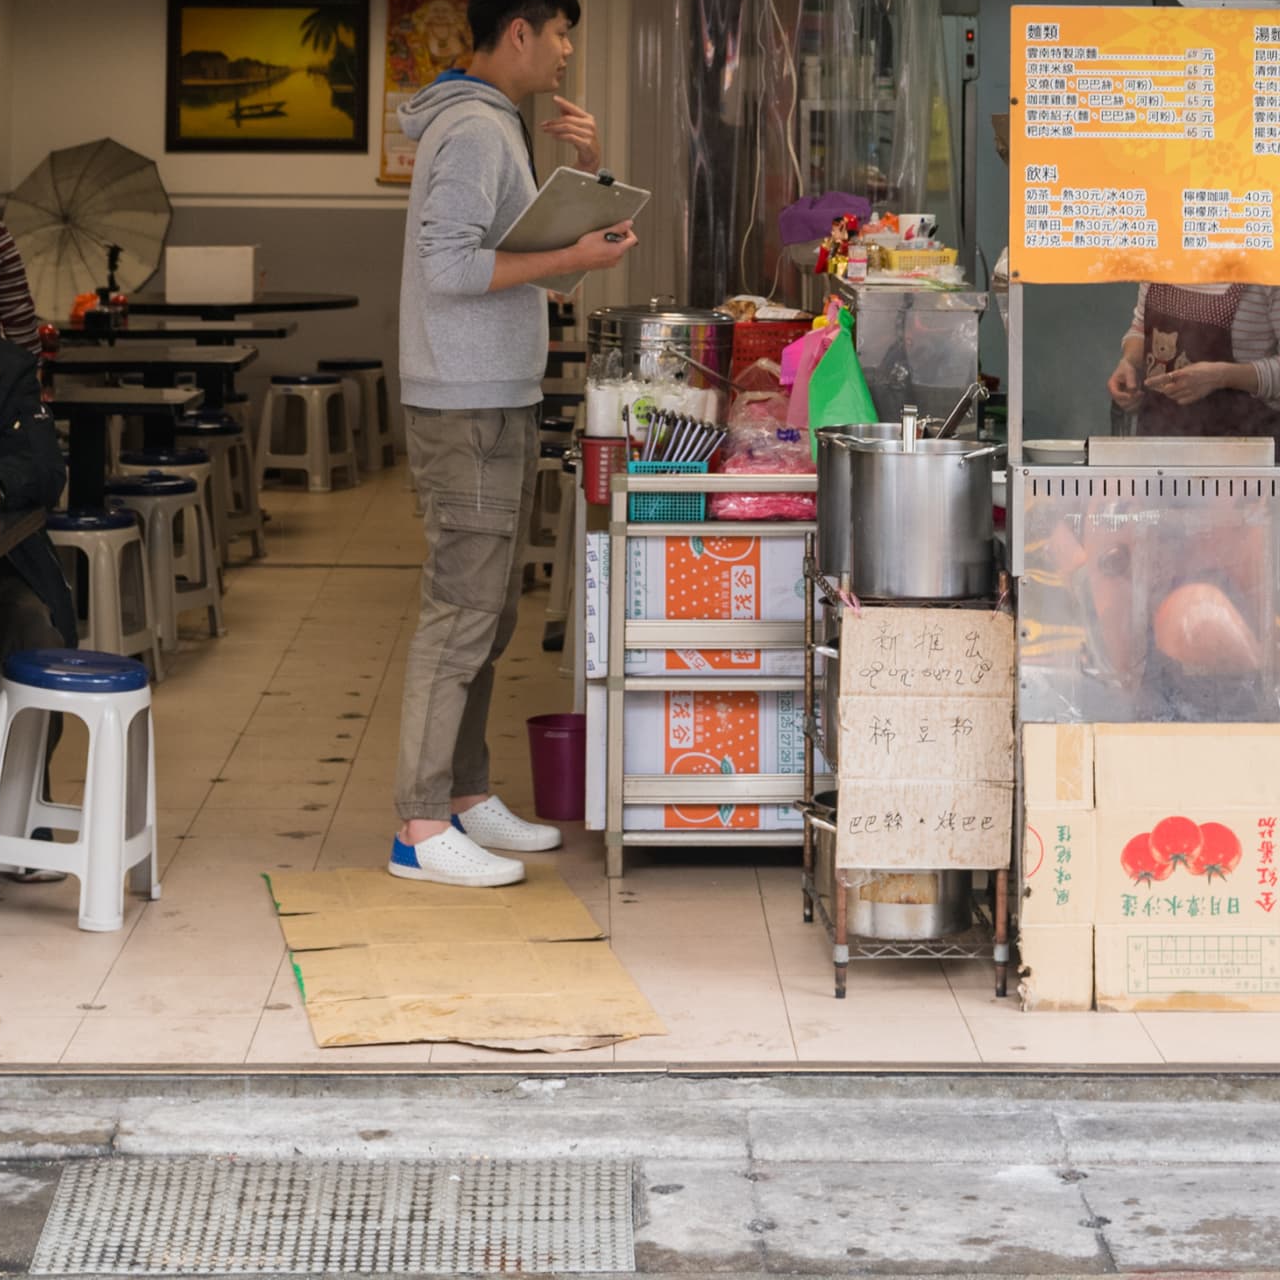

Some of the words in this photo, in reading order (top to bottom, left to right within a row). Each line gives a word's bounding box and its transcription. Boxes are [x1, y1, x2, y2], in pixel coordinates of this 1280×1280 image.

[1027, 24, 1058, 40] 麵類
[1026, 63, 1074, 74] 涼拌米線
[1026, 166, 1058, 181] 飲料
[1026, 190, 1050, 201] 奶茶
[1245, 191, 1272, 202] 40元
[1026, 205, 1050, 216] 咖啡
[1245, 207, 1272, 217] 50元
[1026, 220, 1061, 231] 阿華田
[1183, 222, 1219, 232] 印度冰
[1245, 222, 1272, 232] 60元
[1026, 236, 1061, 247] 好力克
[1245, 237, 1272, 248] 60元
[873, 621, 984, 662] 新推出
[869, 715, 974, 754] 稀豆粉
[1054, 824, 1073, 906] 風味絕佳
[1254, 816, 1278, 913] 全紅蕃茄
